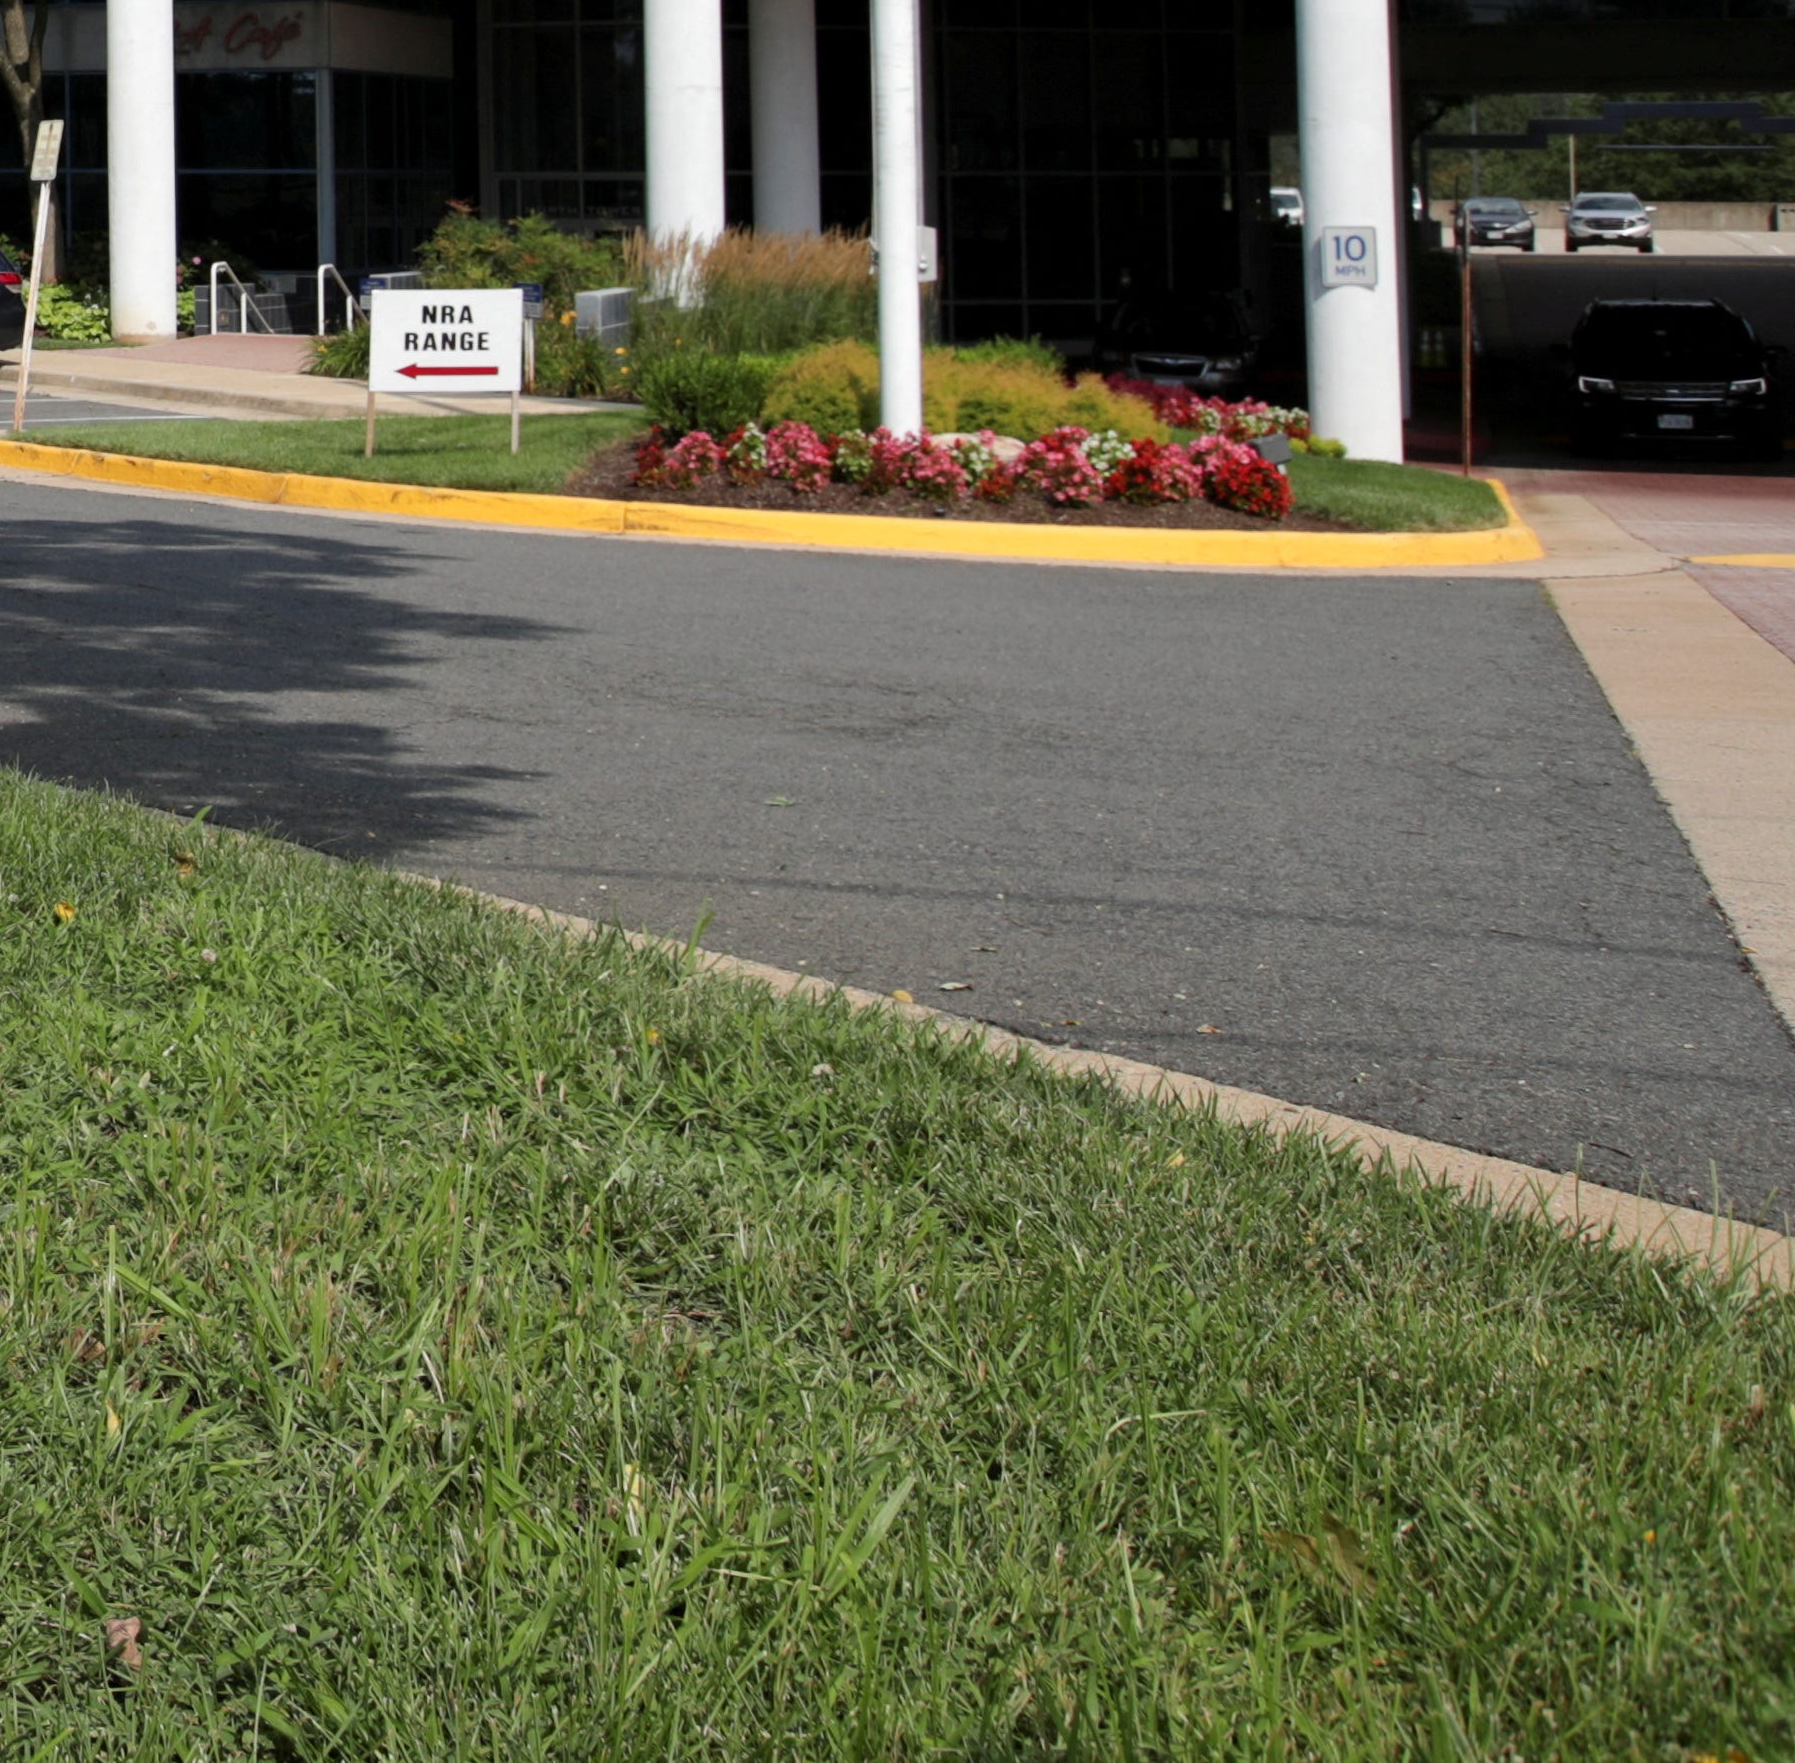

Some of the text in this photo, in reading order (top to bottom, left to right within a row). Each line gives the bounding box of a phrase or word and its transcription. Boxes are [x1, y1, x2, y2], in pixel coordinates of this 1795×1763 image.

[1332, 235, 1366, 261] 10
[1335, 265, 1366, 276] MPH
[421, 305, 474, 324] NRA
[404, 332, 490, 351] RANGE
